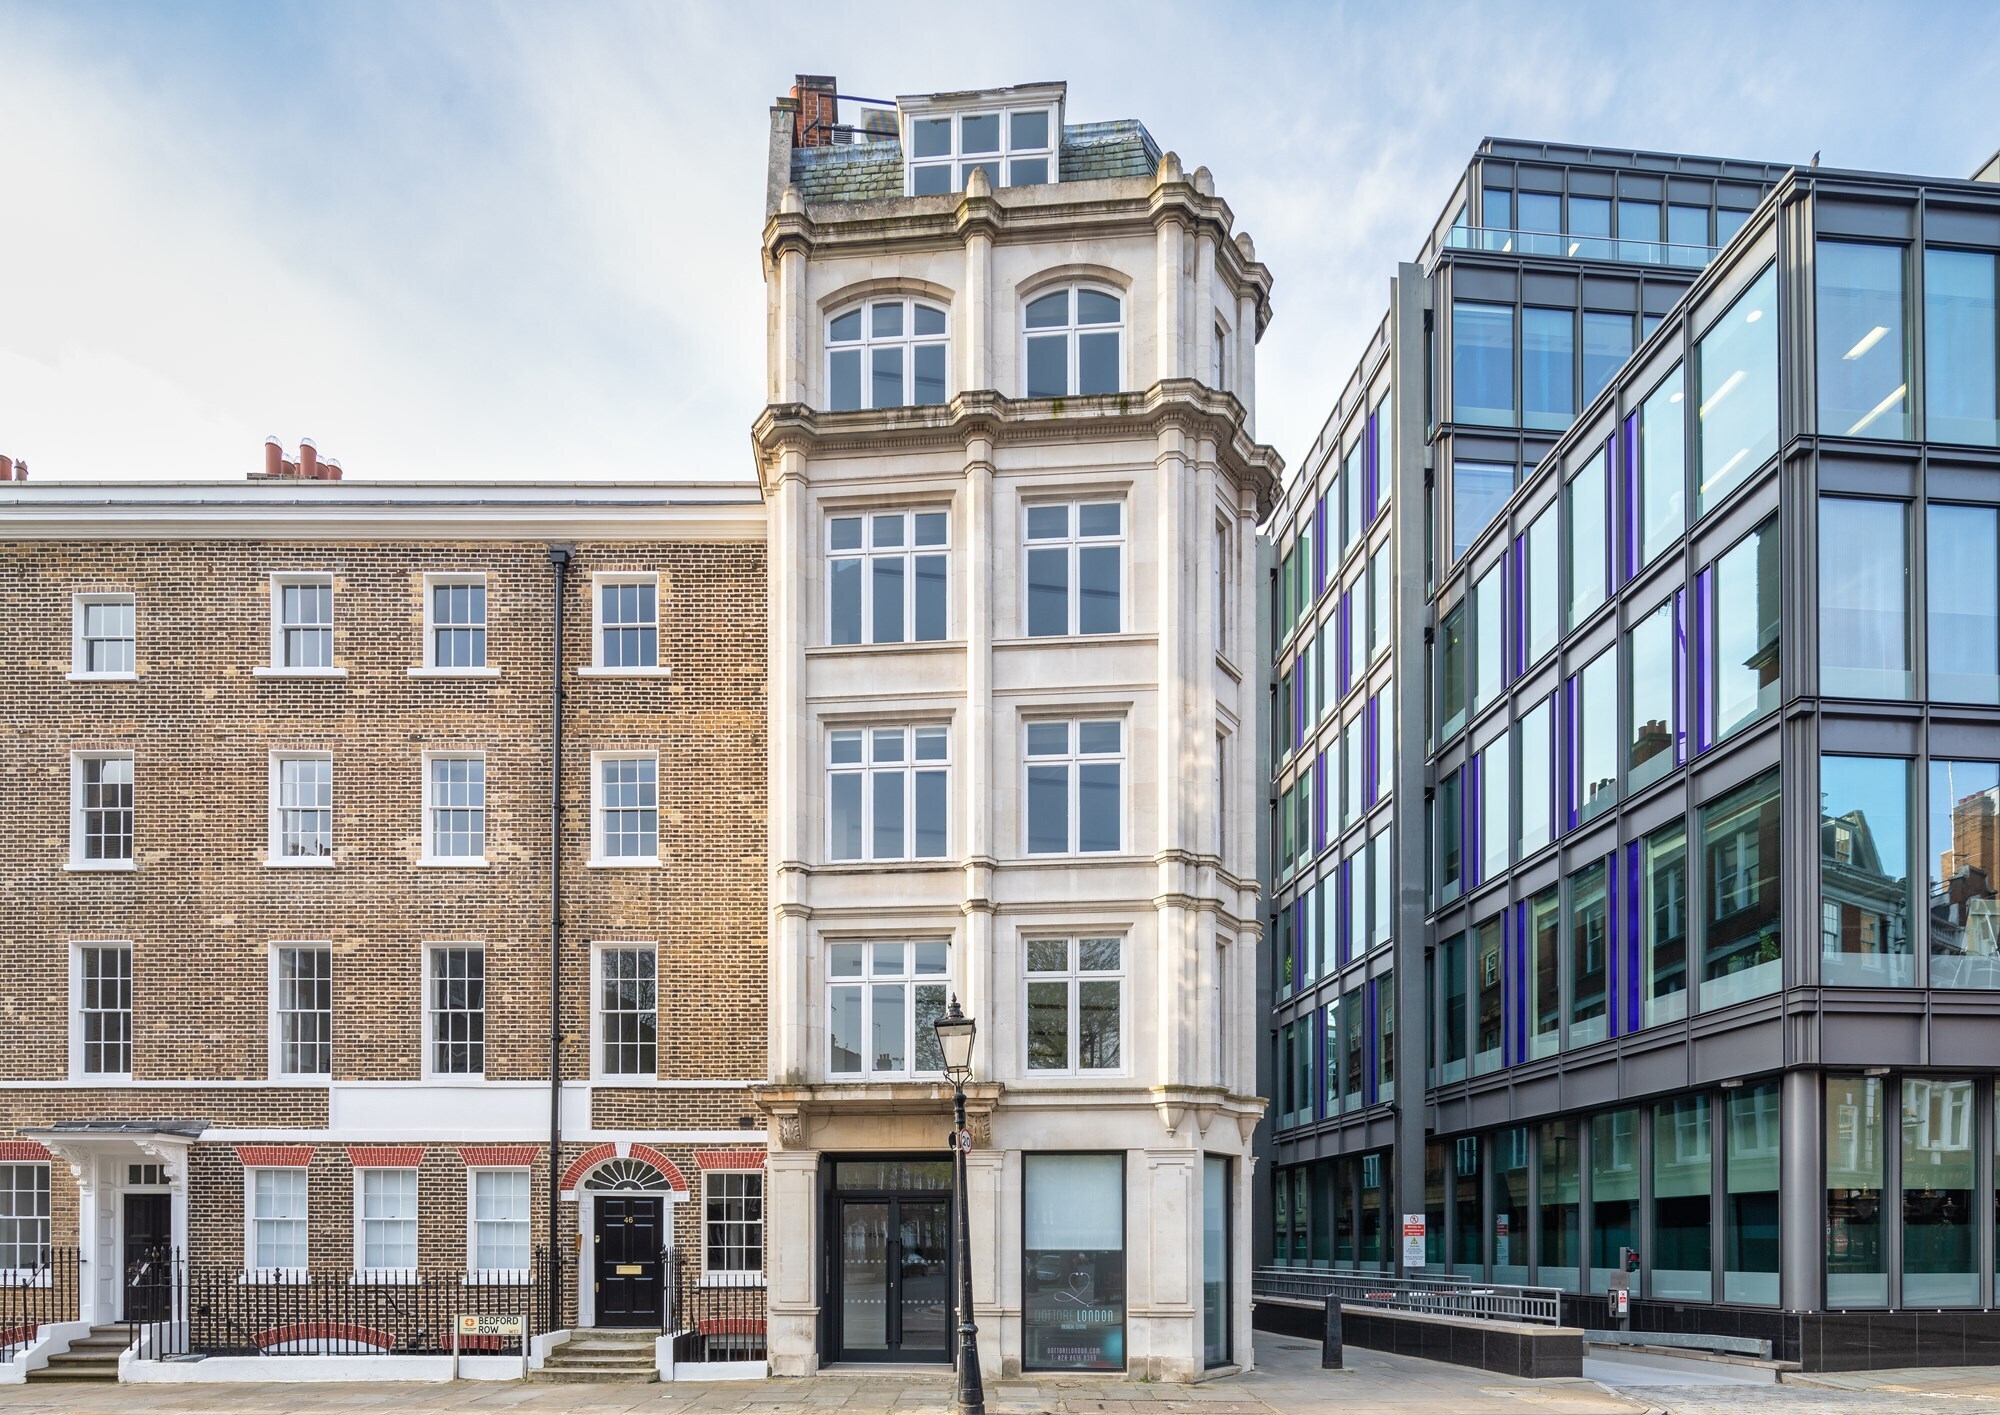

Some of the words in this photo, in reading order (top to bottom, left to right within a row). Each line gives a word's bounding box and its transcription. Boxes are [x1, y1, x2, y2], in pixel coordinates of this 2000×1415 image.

[962, 1135, 971, 1148] 20
[624, 1216, 634, 1224] 46
[1034, 1309, 1074, 1322] DOTTORE
[1077, 1309, 1114, 1322] LONDON
[478, 1316, 519, 1325] BEDFORD
[478, 1325, 499, 1334] ROW
